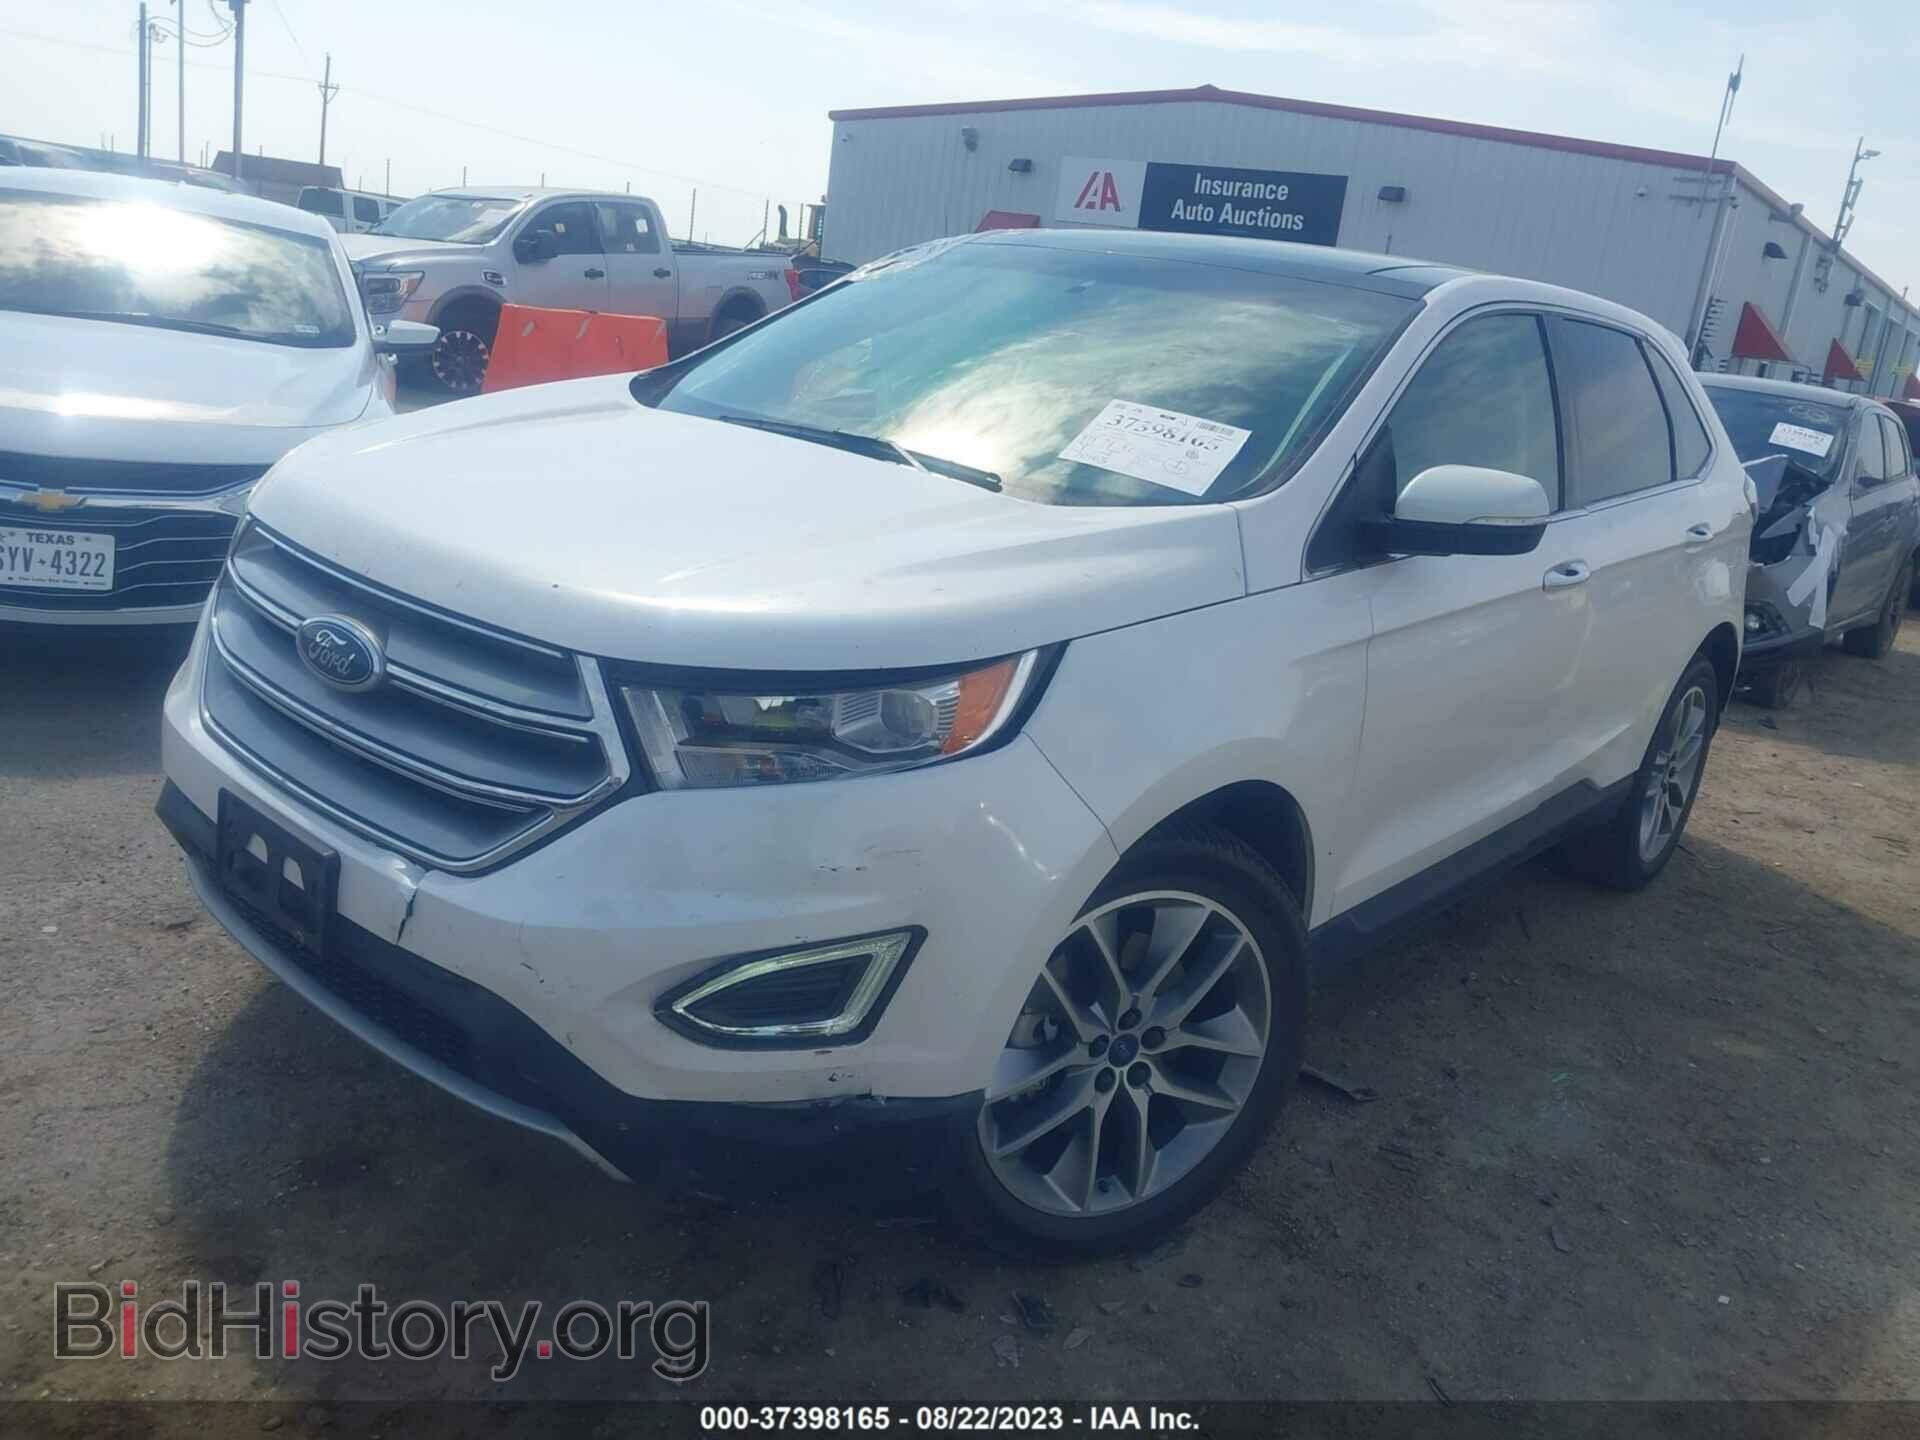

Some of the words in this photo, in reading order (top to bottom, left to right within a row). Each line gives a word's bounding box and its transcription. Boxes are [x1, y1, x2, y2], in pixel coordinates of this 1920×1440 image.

[1194, 173, 1289, 201] Insurance
[1171, 199, 1214, 223] Auto
[1218, 203, 1304, 231] Auctions
[26, 532, 74, 545] TEXAS
[308, 628, 356, 676] Ford
